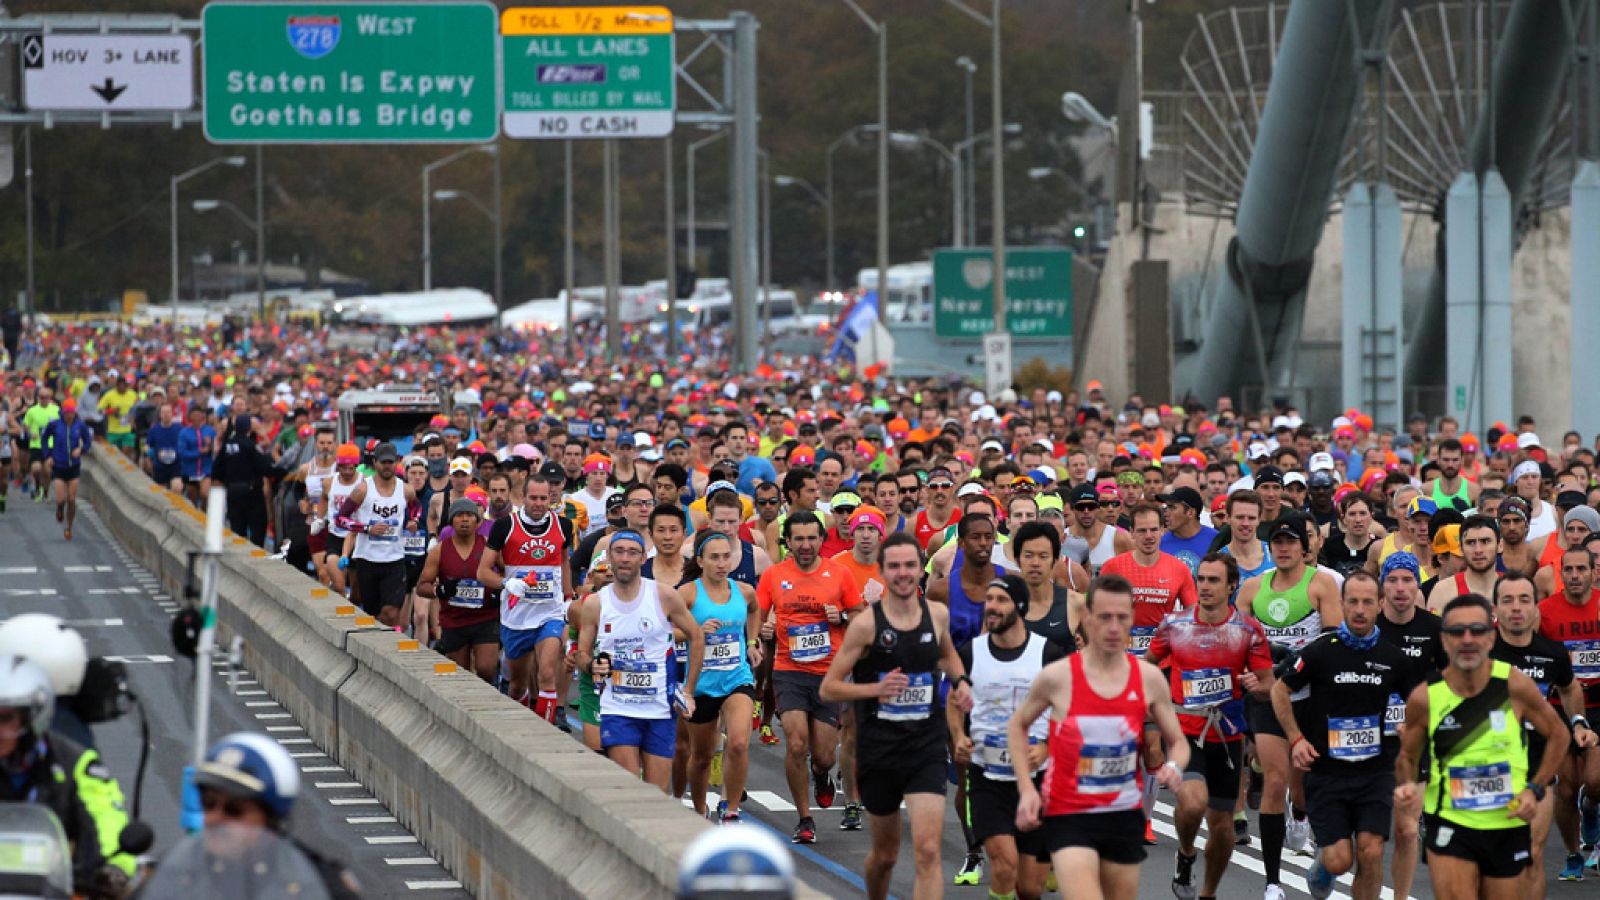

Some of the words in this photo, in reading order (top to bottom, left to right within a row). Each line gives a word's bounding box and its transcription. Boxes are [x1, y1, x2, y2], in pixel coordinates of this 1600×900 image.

[520, 15, 561, 29] TOLL
[296, 27, 334, 49] 278
[526, 39, 569, 57] ALL
[577, 38, 650, 57] LANES
[52, 50, 88, 63] HOV
[133, 50, 181, 63] LANE
[618, 65, 641, 81] OR
[227, 71, 326, 93] Staten
[340, 71, 364, 93] Is
[380, 71, 474, 97] Expwy
[511, 91, 544, 107] TOLL
[552, 91, 599, 107] BILLED
[606, 91, 625, 106] BY
[633, 91, 664, 106] MAIL
[230, 104, 361, 126] Goethals
[376, 104, 472, 131] Bridge
[540, 118, 569, 133] NO
[579, 117, 638, 133] CASH
[940, 298, 982, 312] New
[373, 503, 398, 518] USA
[519, 538, 556, 554] ITALIA
[801, 634, 826, 648] 2469
[712, 645, 730, 657] 495
[622, 674, 652, 687] 2023
[1198, 677, 1226, 695] 2203
[1346, 731, 1375, 745] 2026
